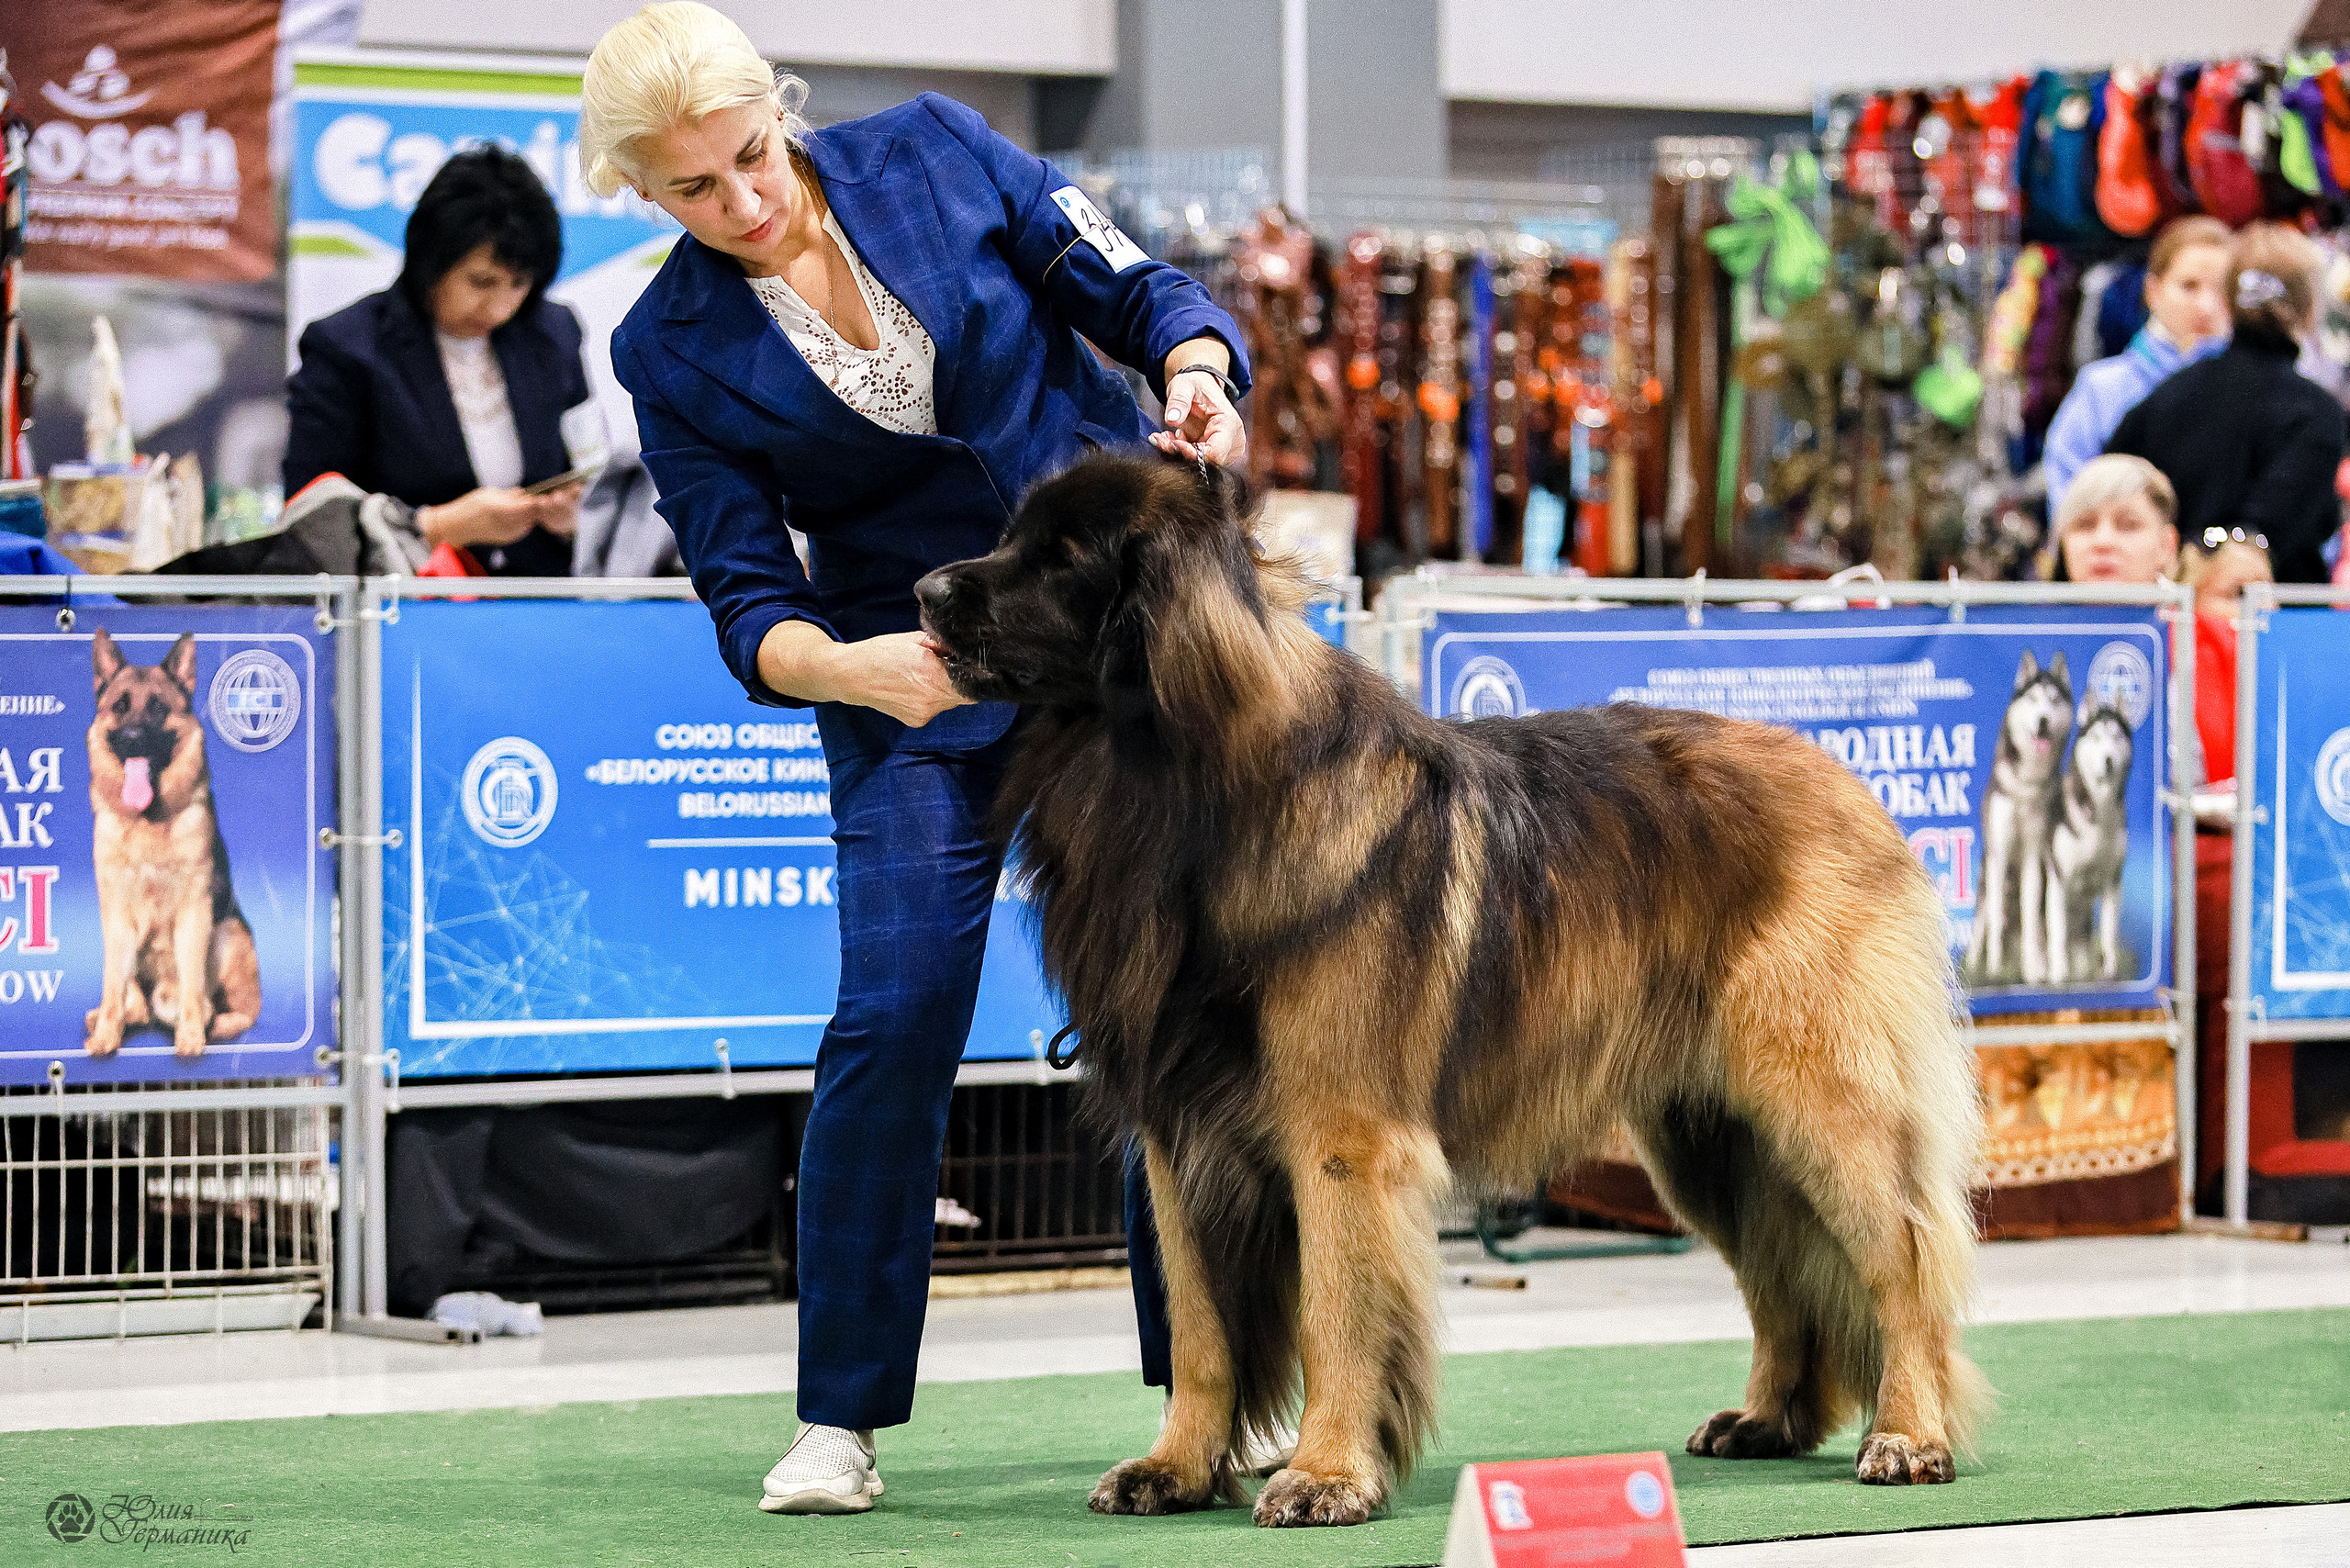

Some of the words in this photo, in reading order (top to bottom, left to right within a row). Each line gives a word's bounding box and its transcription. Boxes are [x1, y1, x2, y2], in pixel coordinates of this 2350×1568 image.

[27, 111, 241, 189] osch
[656, 723, 733, 749] СОЮЗ
[1804, 725, 1975, 774] РОДНАЯ
[1863, 772, 1971, 818] ОБАК
[685, 867, 834, 907] MINSK
